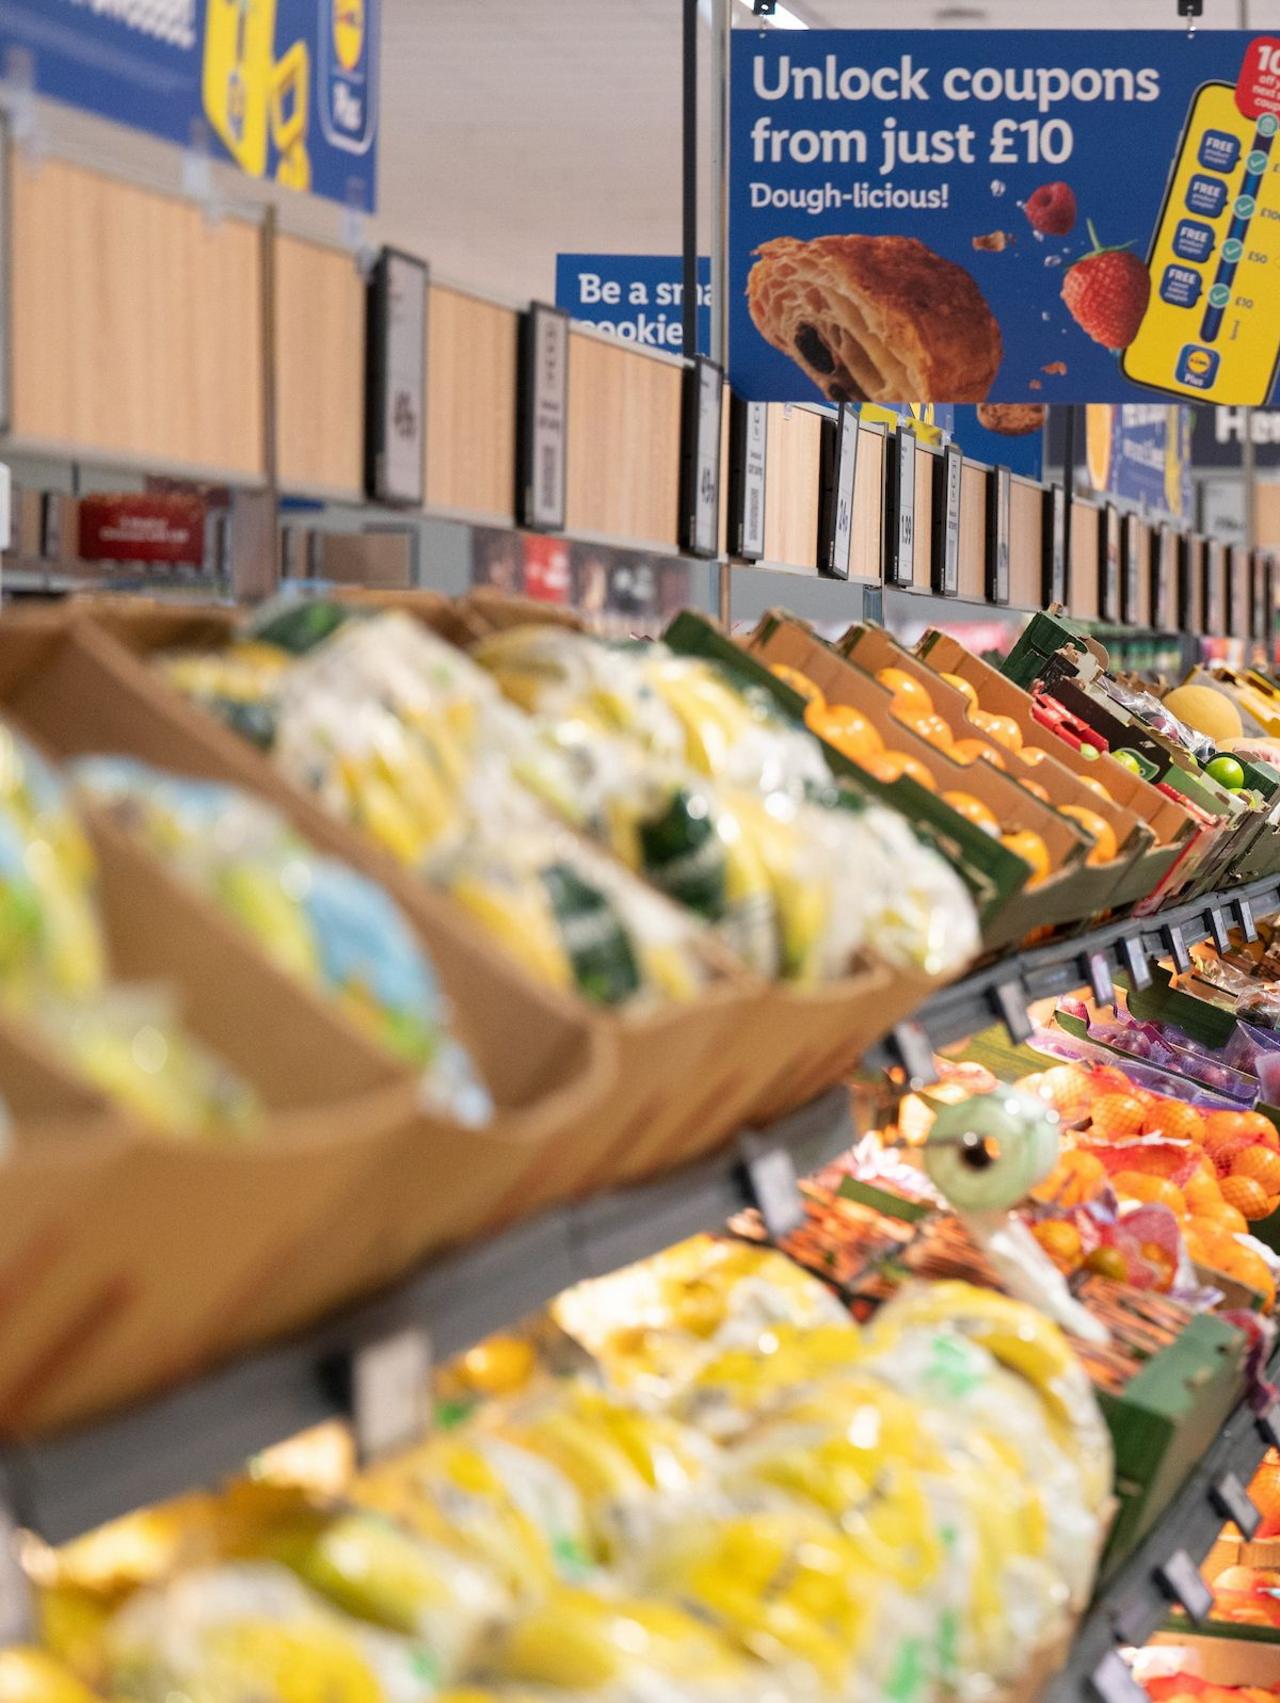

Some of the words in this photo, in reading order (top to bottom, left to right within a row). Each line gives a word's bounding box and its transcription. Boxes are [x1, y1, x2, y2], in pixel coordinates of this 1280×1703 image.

[753, 54, 930, 101] Unlock
[942, 67, 1161, 113] coupons
[751, 117, 867, 163] from
[879, 116, 975, 175] just
[989, 117, 1074, 165] £10
[1204, 136, 1234, 153] FREE
[749, 182, 949, 214] Dough-licious!
[1192, 181, 1221, 198] FREE
[1180, 226, 1209, 243] FREE
[1248, 251, 1268, 264] £50
[1168, 268, 1197, 286] FREE
[578, 273, 621, 304] Be
[628, 281, 649, 305] a
[1235, 296, 1254, 309] £10
[1184, 373, 1204, 387] Plus
[901, 514, 912, 546] 1.99
